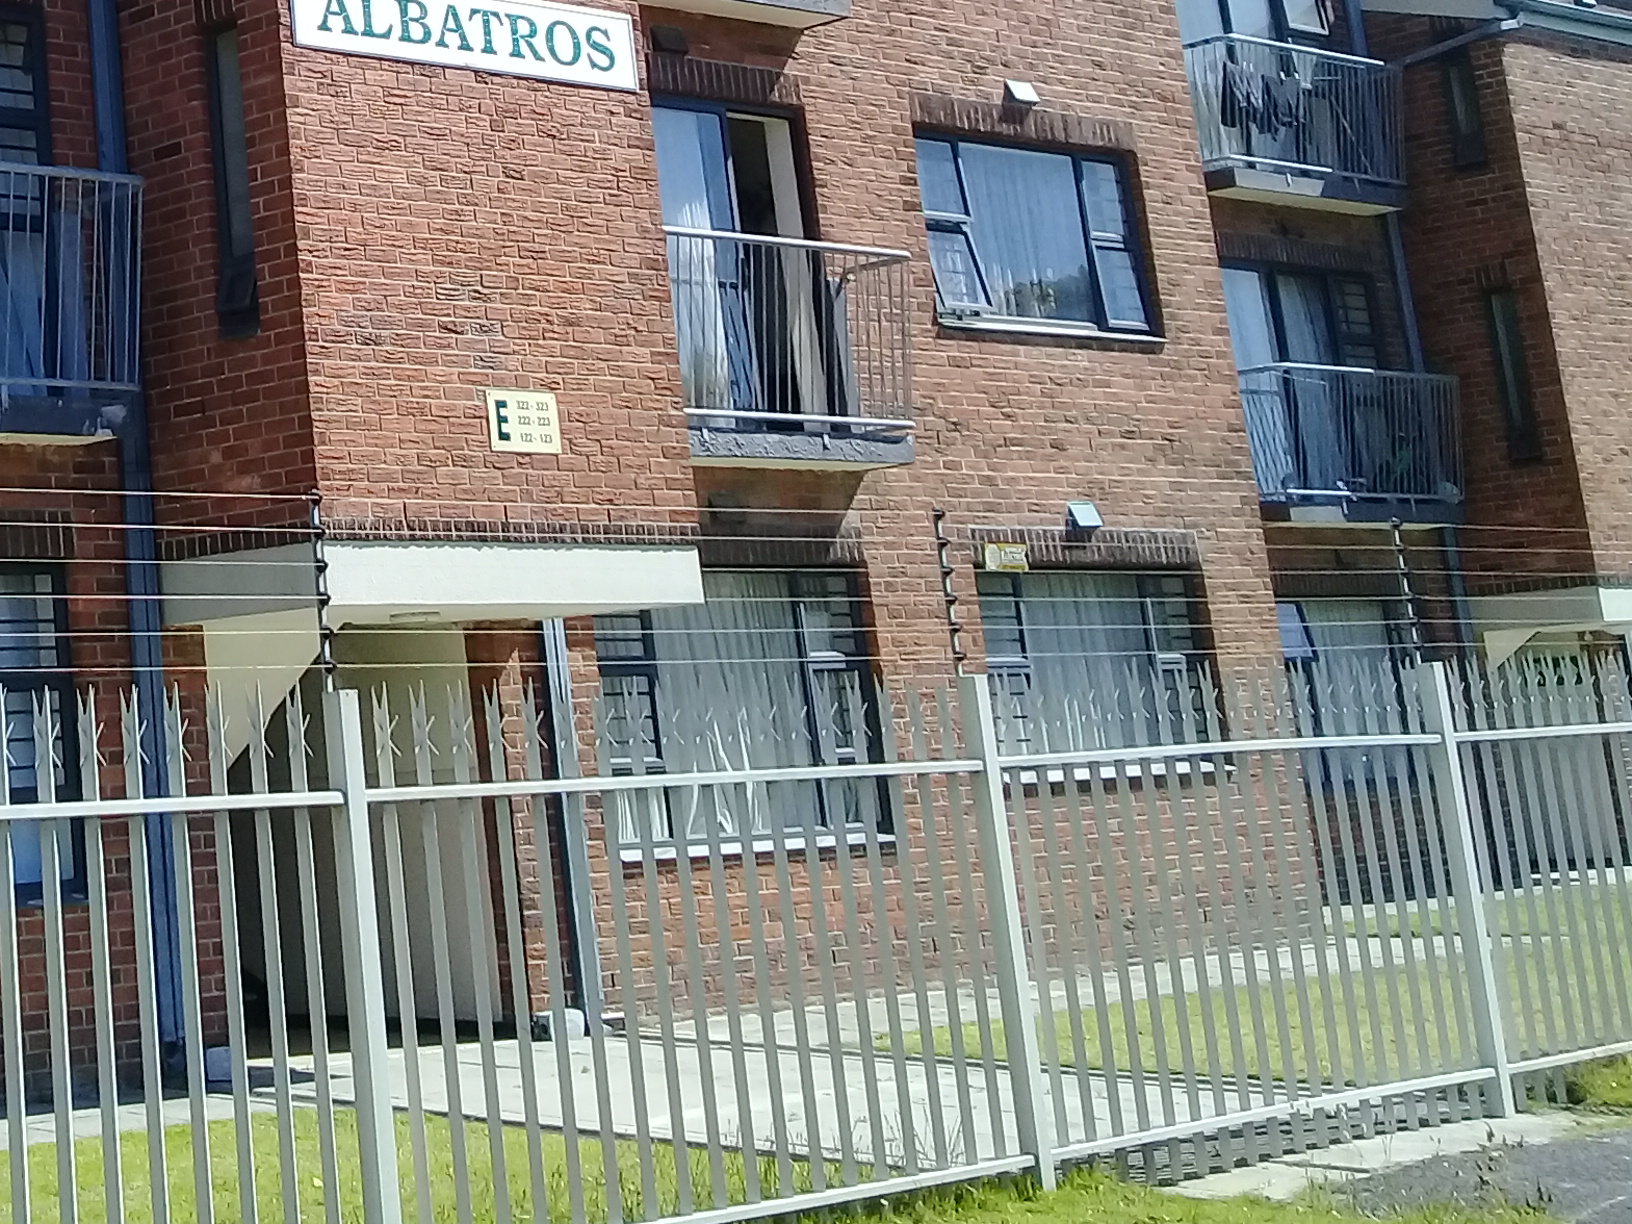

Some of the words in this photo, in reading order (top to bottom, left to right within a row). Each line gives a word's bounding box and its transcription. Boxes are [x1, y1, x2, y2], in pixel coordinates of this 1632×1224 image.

[516, 400, 529, 410] 322
[535, 401, 549, 411] 323
[494, 399, 511, 441] E
[518, 415, 531, 425] 222
[537, 416, 551, 427] 223
[520, 433, 533, 443] 122
[540, 433, 553, 444] 123
